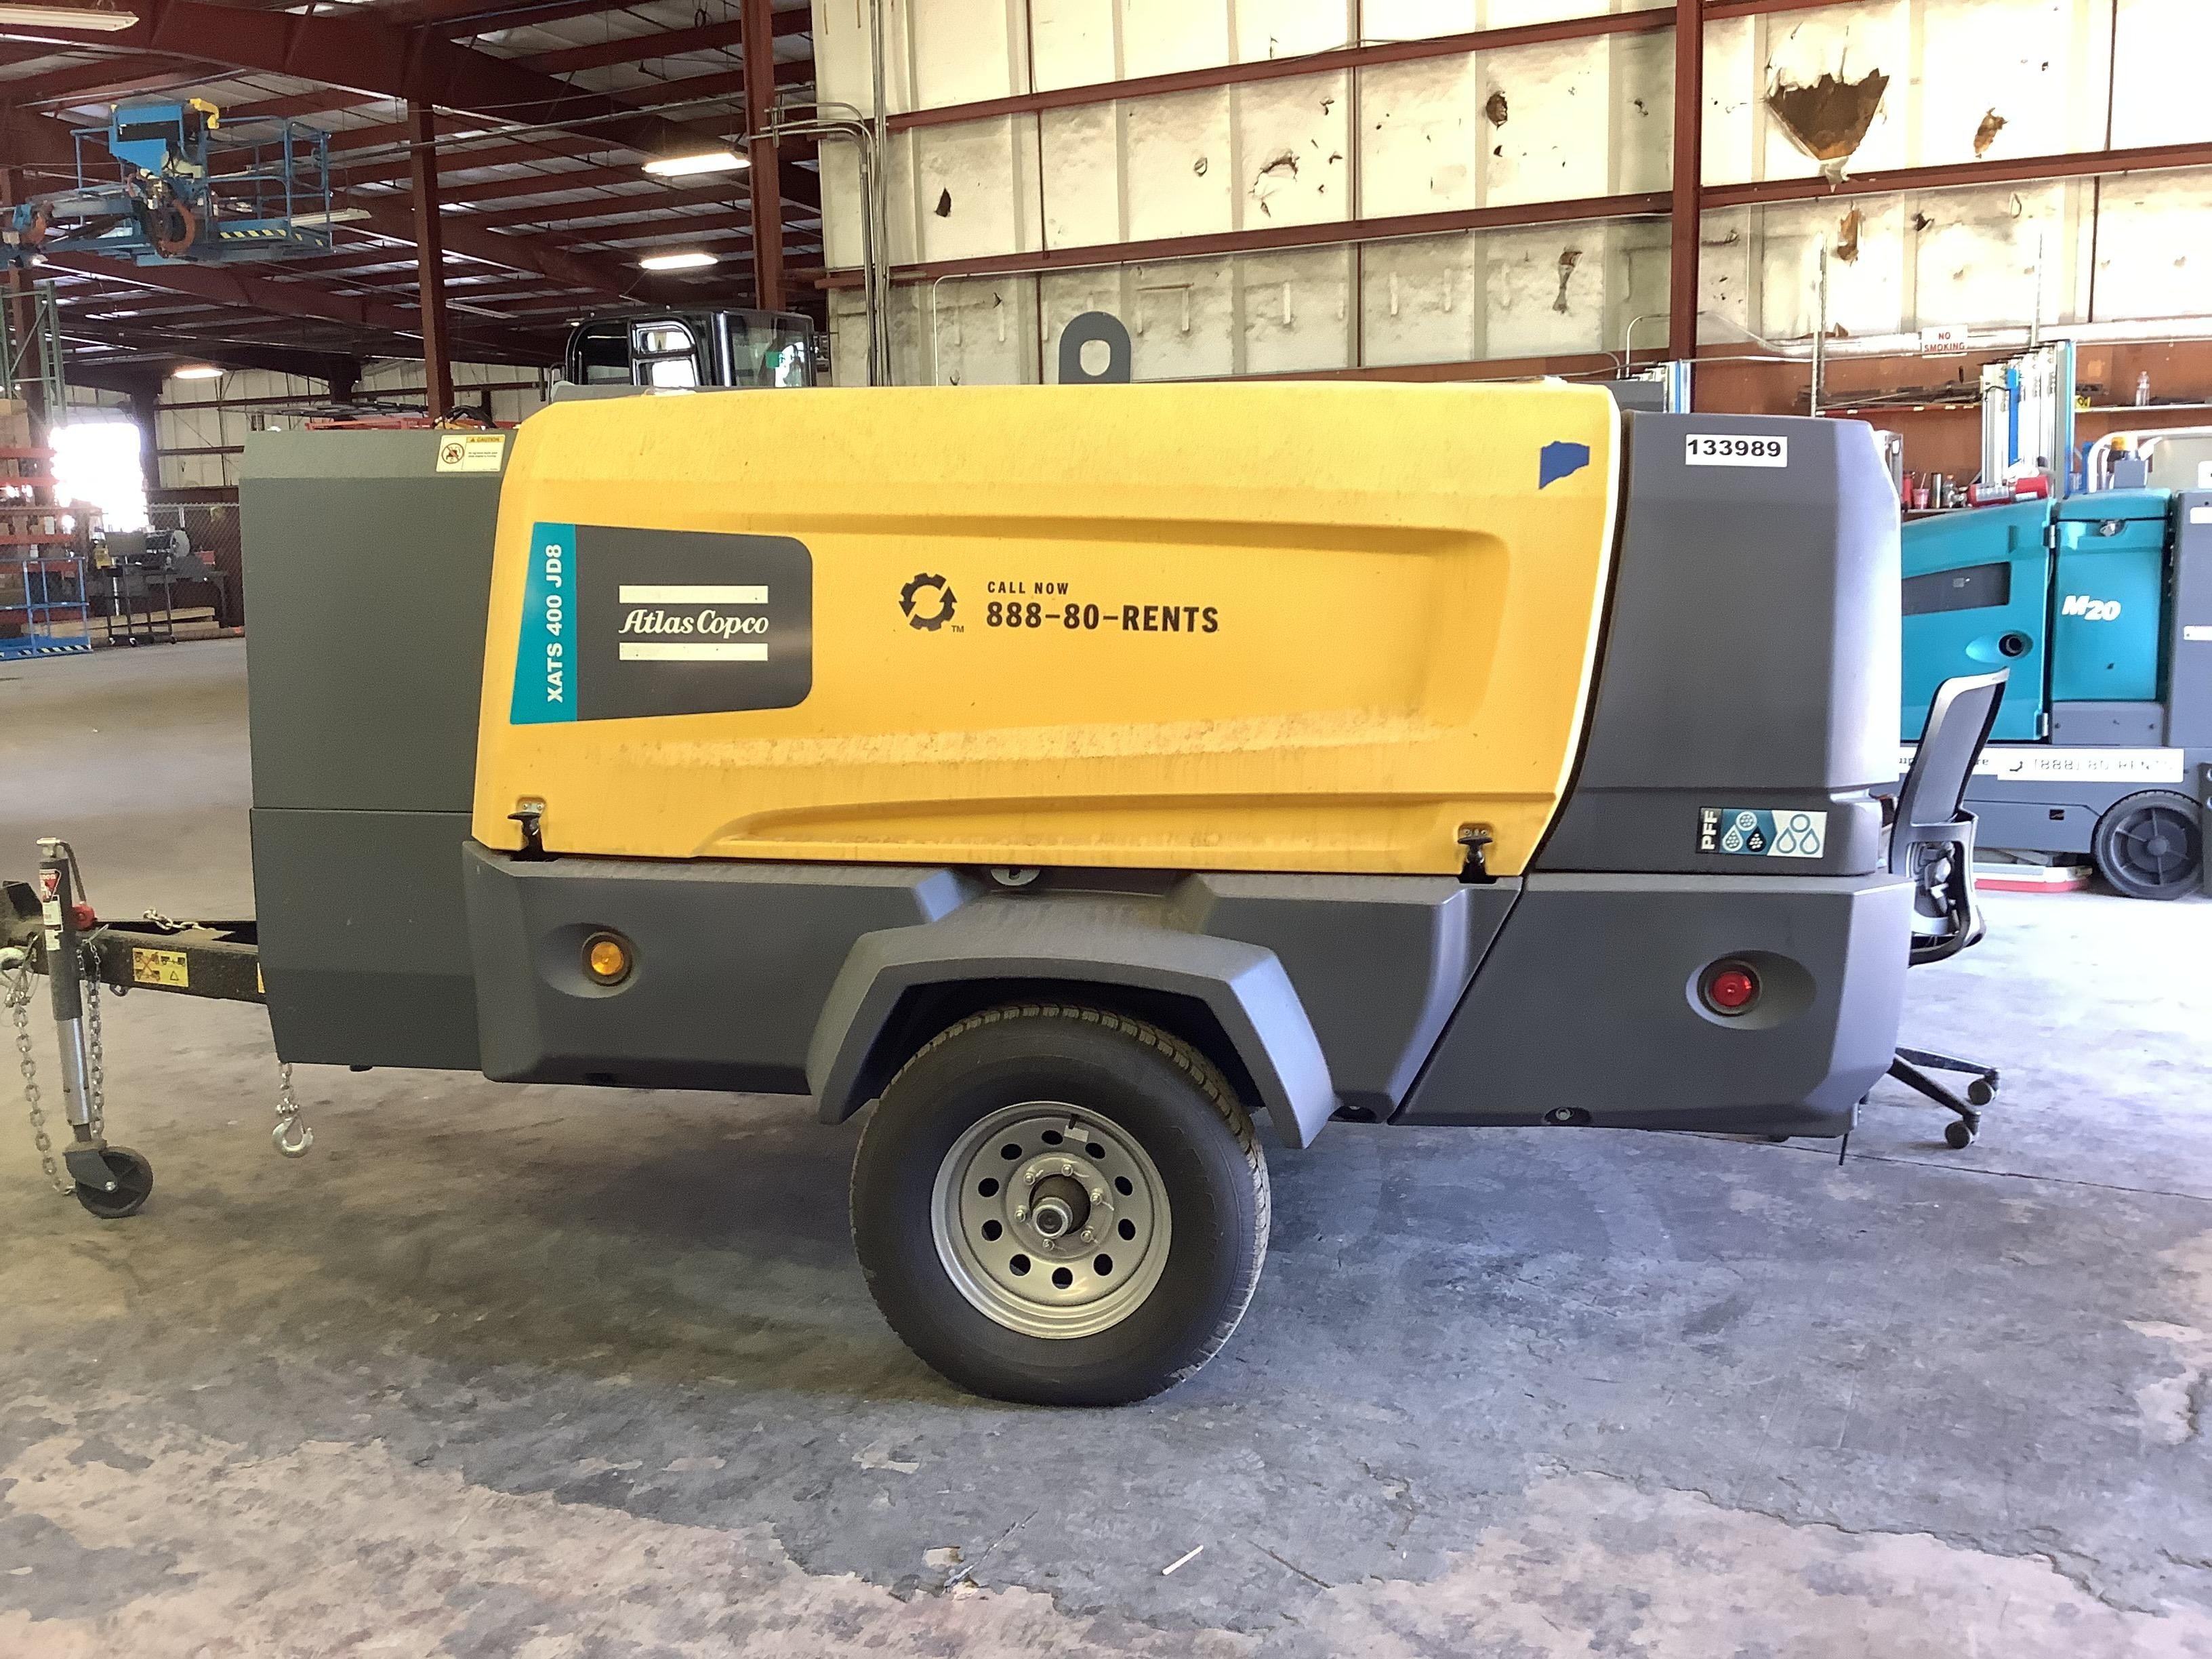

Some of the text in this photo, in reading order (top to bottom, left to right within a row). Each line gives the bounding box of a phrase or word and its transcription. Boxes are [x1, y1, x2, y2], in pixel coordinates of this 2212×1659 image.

[1924, 342, 1965, 352] SMOKING
[1938, 331, 1951, 340] NO
[1687, 438, 1781, 457] 133989
[987, 581, 1069, 595] CALL NOW
[986, 601, 1219, 634] 888-80-RENTS
[2062, 595, 2122, 621] M20
[544, 544, 563, 703] XATS 400 JD8
[618, 609, 769, 639] Atlas Copco
[1701, 810, 1718, 850] PFF
